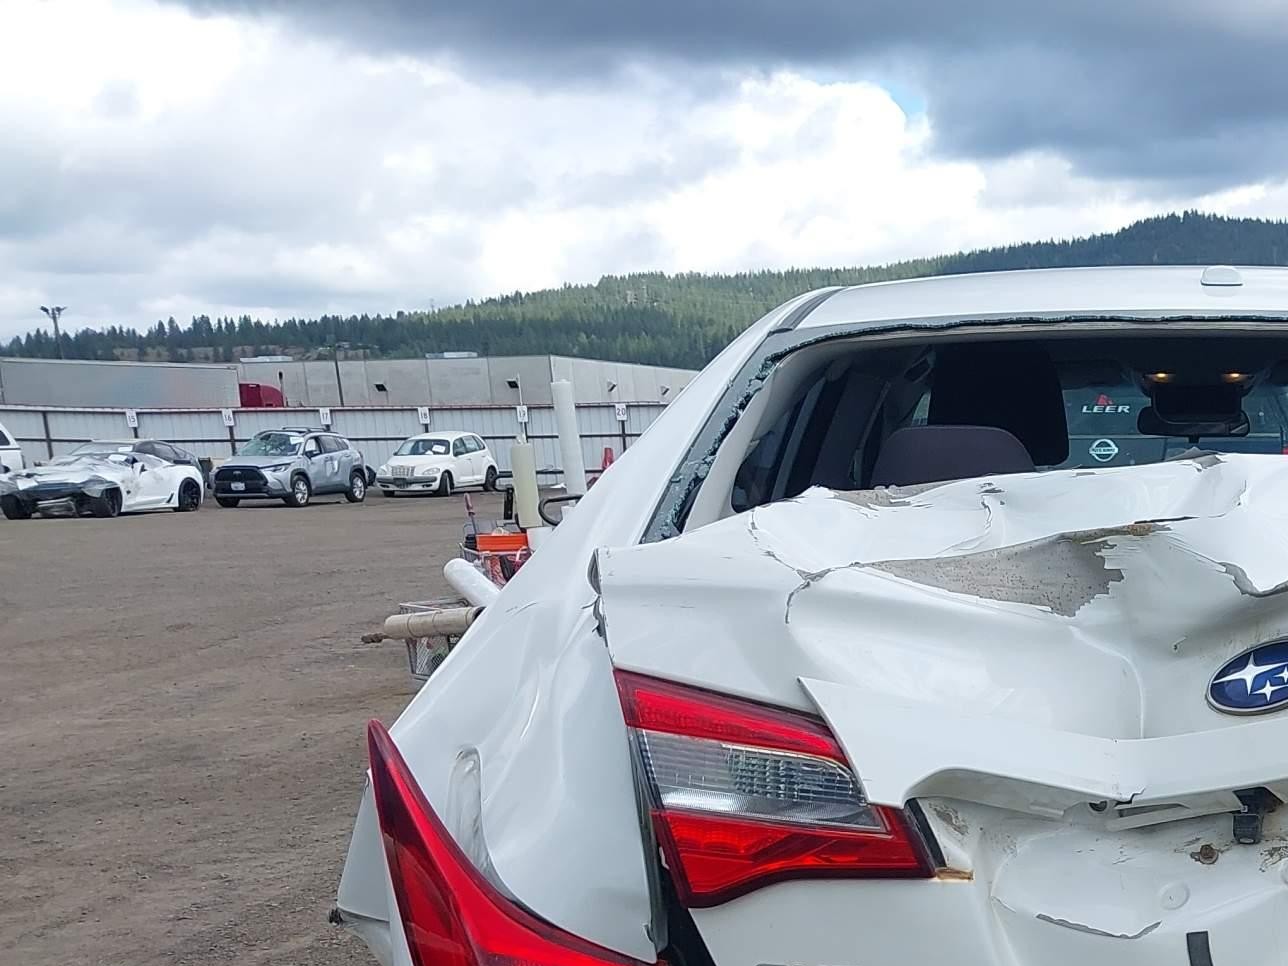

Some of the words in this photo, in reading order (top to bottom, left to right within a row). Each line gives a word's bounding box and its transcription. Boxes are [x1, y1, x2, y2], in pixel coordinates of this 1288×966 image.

[616, 407, 626, 416] 20
[1082, 405, 1130, 413] LEER
[128, 415, 136, 423] 15
[224, 414, 232, 422] 16
[321, 412, 329, 421] 17
[420, 411, 428, 420] 18
